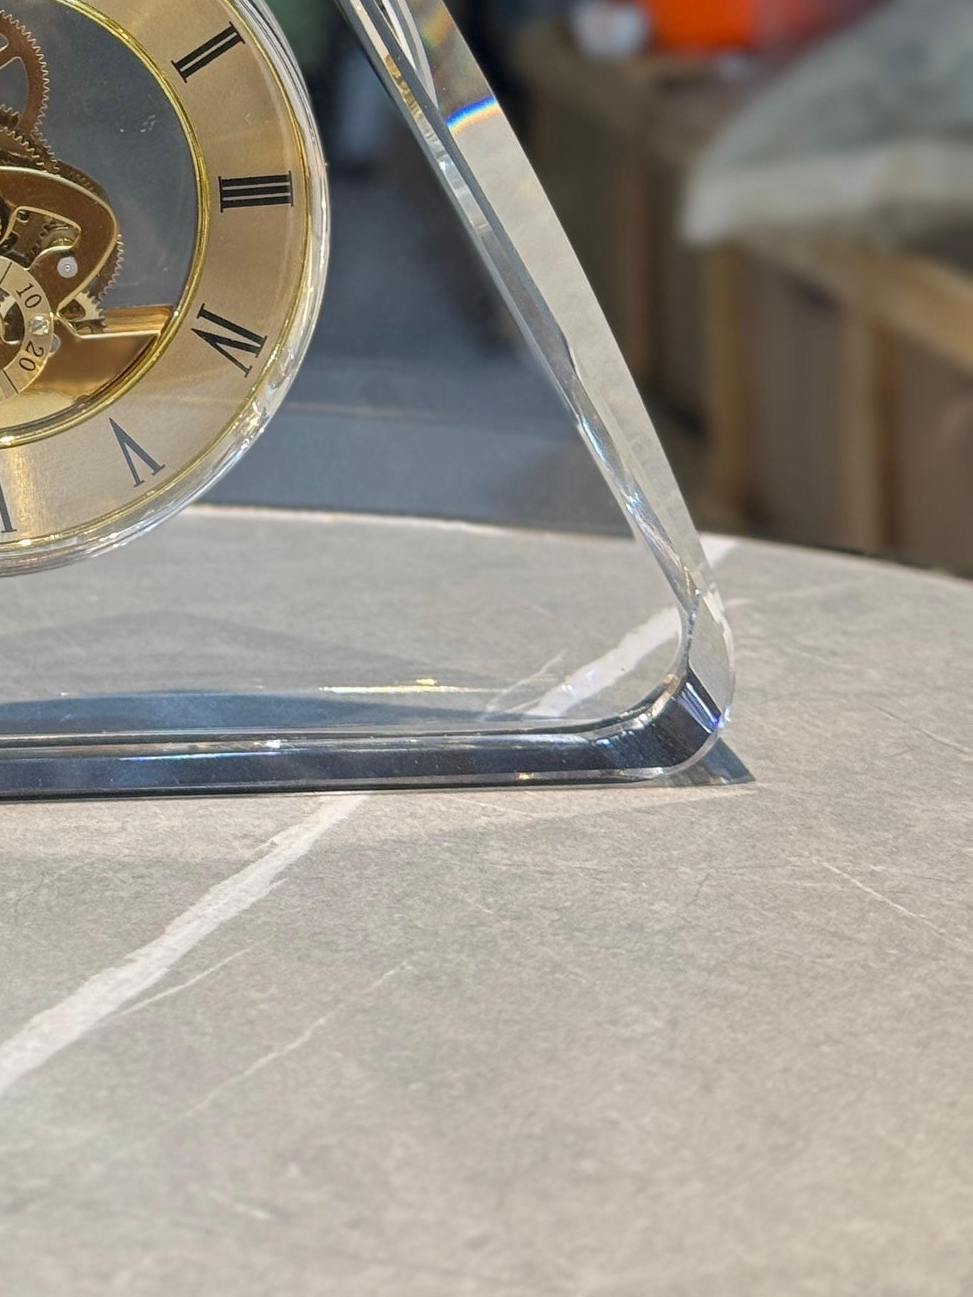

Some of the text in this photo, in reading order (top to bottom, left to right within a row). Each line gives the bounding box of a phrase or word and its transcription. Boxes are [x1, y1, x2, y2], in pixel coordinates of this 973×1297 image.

[172, 22, 245, 83] II
[219, 170, 294, 213] III
[16, 283, 42, 309] 10
[18, 340, 44, 372] 20
[190, 303, 268, 377] IV
[110, 417, 165, 487] V
